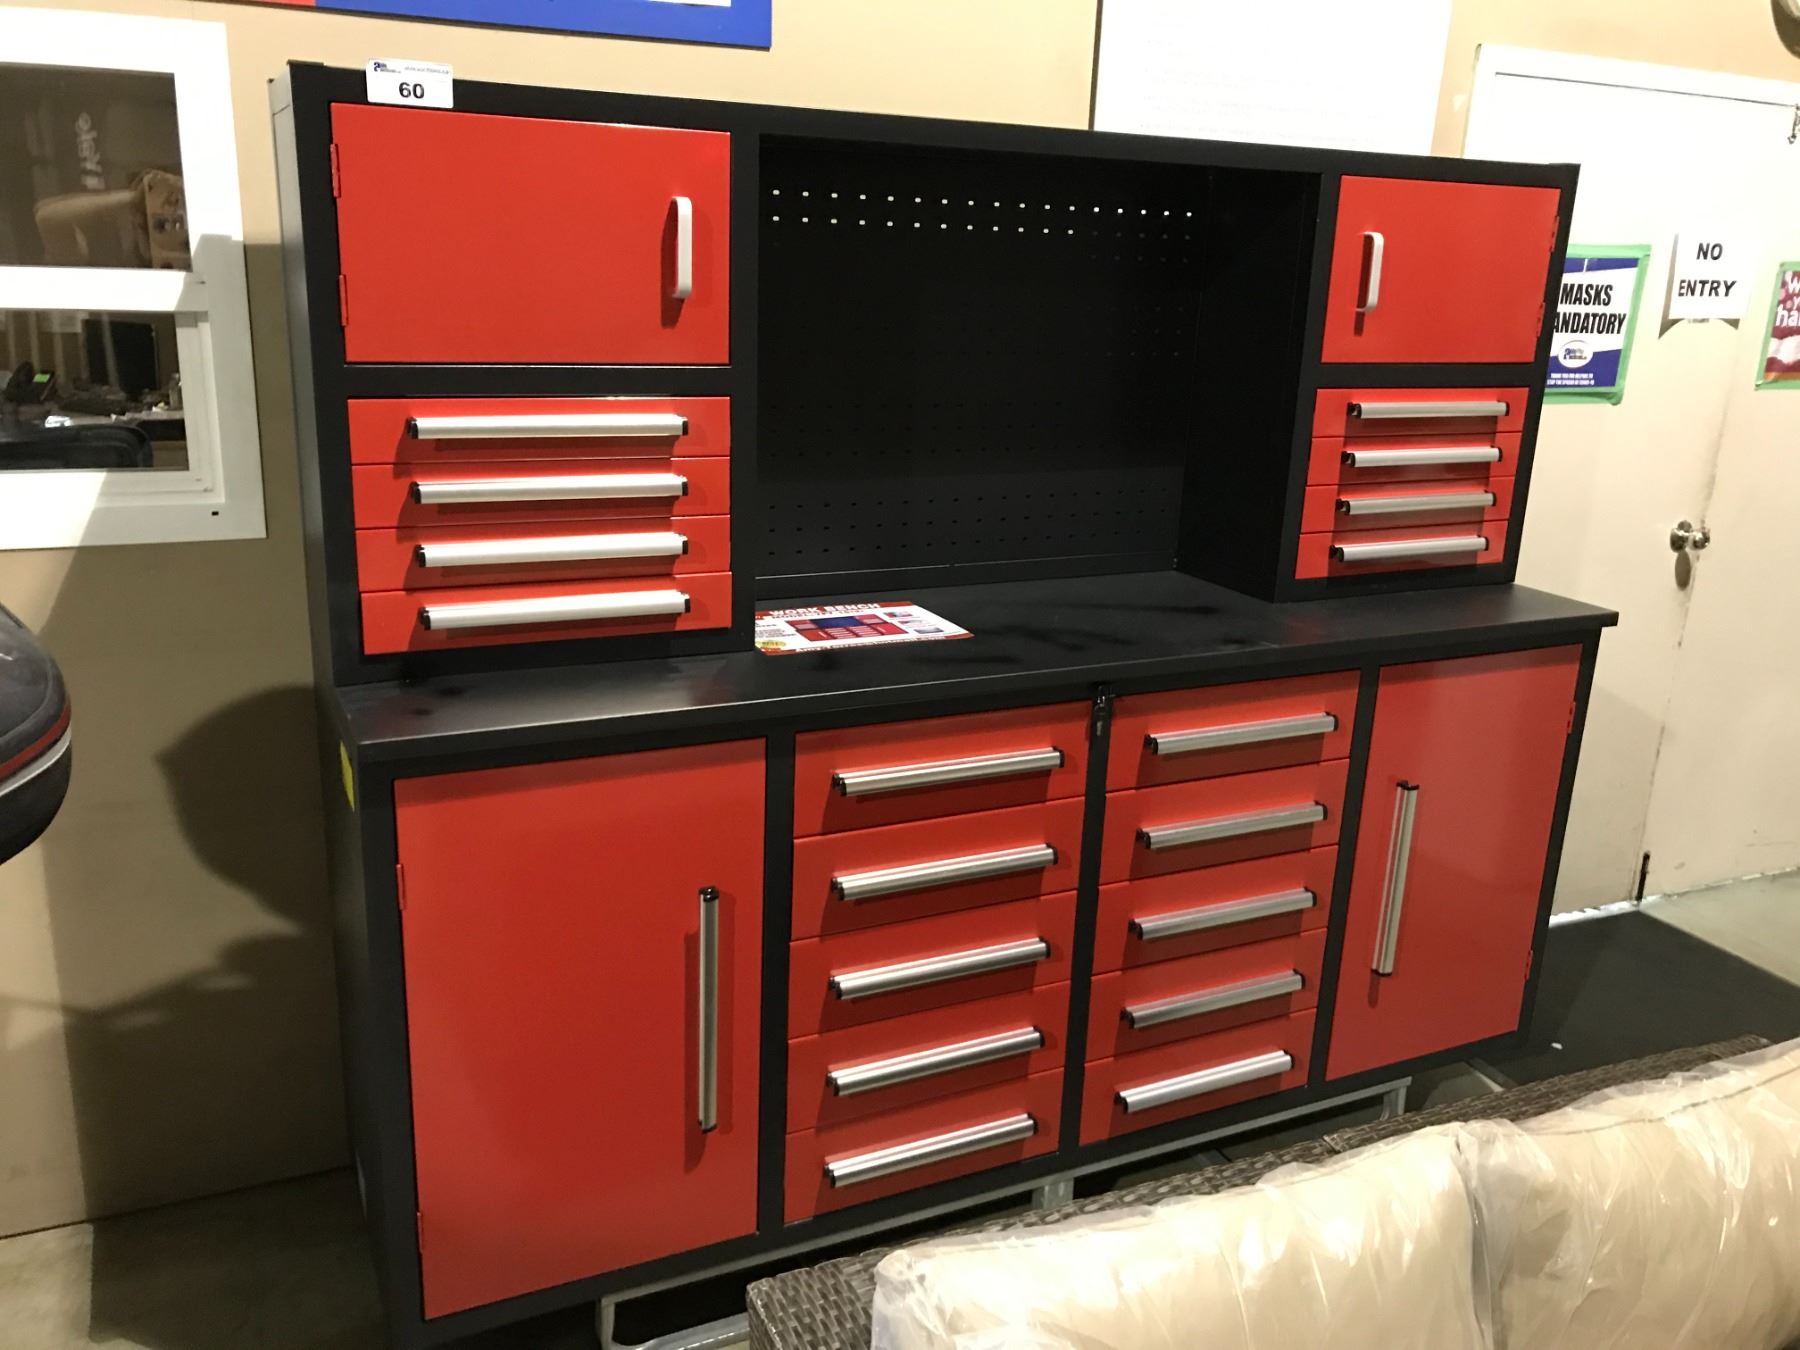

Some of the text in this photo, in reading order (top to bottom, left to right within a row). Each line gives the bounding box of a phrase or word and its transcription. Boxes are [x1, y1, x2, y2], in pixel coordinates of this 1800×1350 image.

[398, 82, 425, 99] 60
[1696, 242, 1724, 261] NO
[1560, 283, 1614, 307] MASKS
[1678, 279, 1737, 297] ENTRY
[1552, 311, 1627, 335] ANDATORY
[1775, 303, 1800, 327] ha
